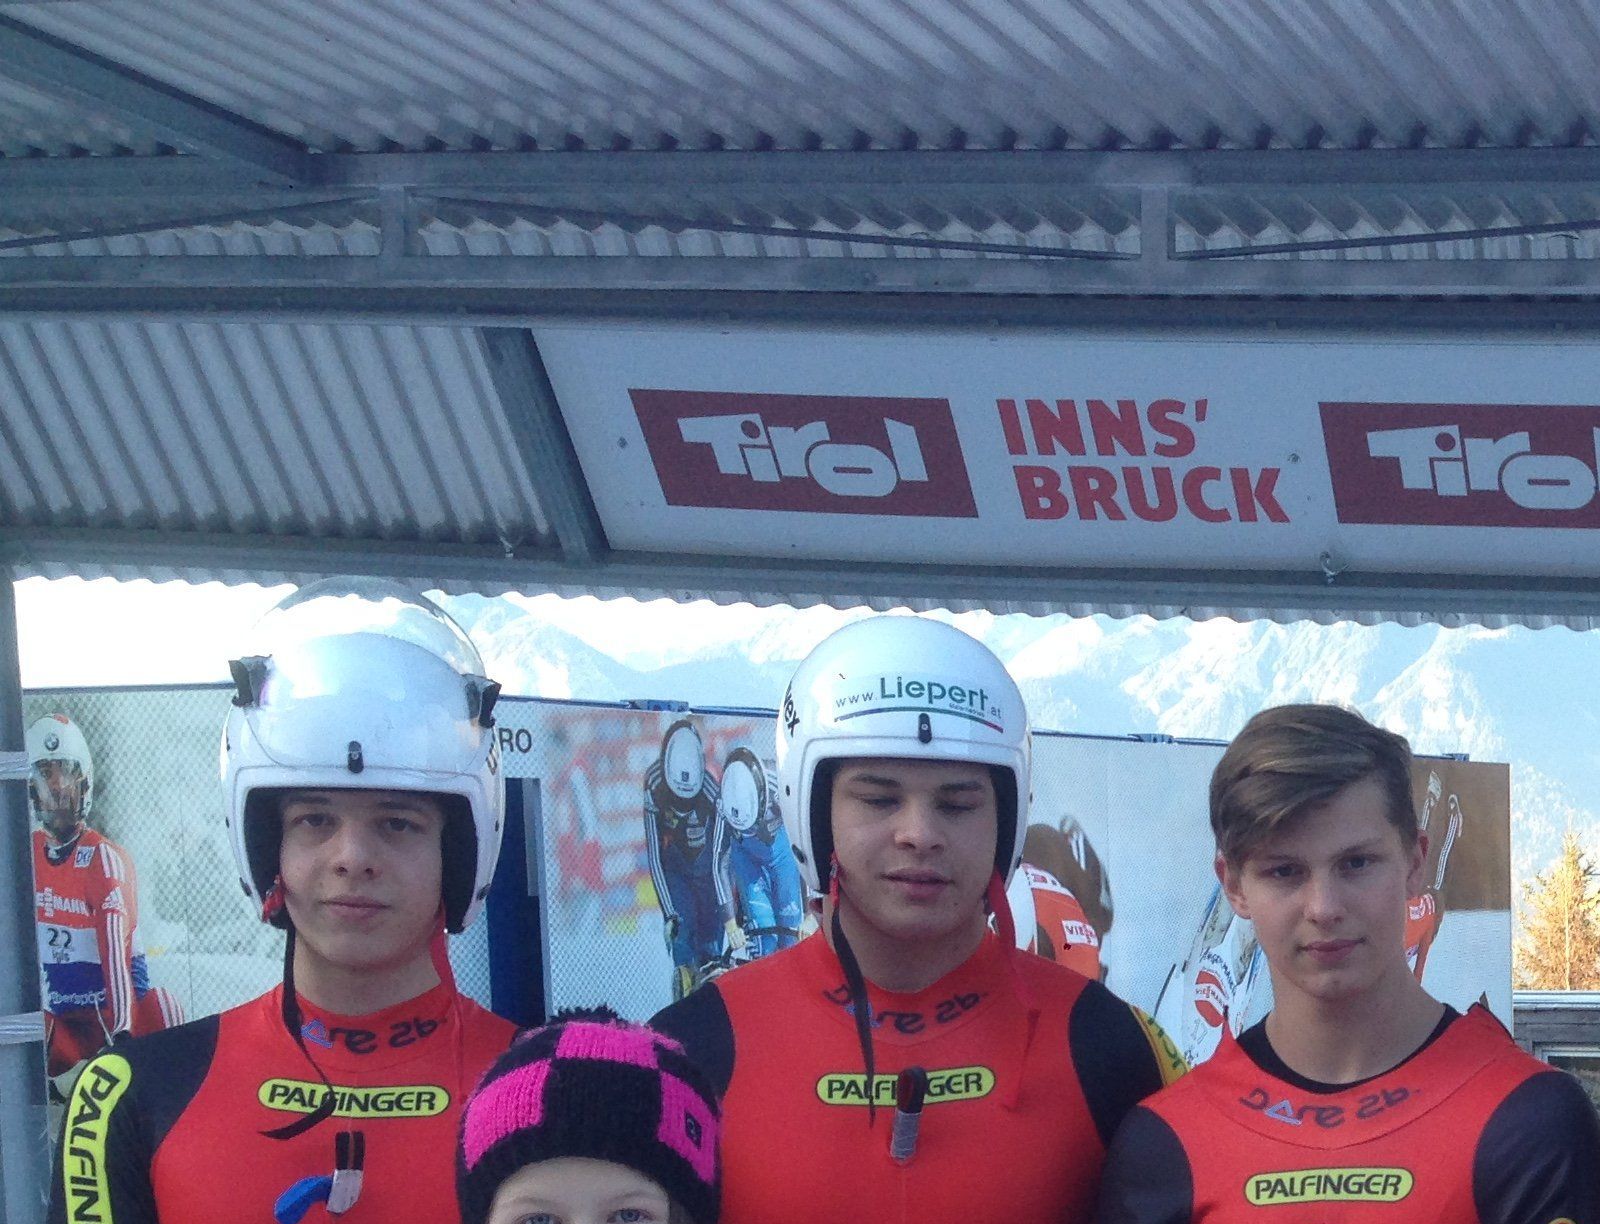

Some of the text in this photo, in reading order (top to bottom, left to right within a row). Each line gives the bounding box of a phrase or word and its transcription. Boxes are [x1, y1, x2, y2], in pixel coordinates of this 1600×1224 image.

[677, 412, 930, 498] Tirol
[1012, 465, 1291, 525] BRUCK
[499, 727, 533, 754] RO
[1255, 1174, 1403, 1200] PALFINGER
